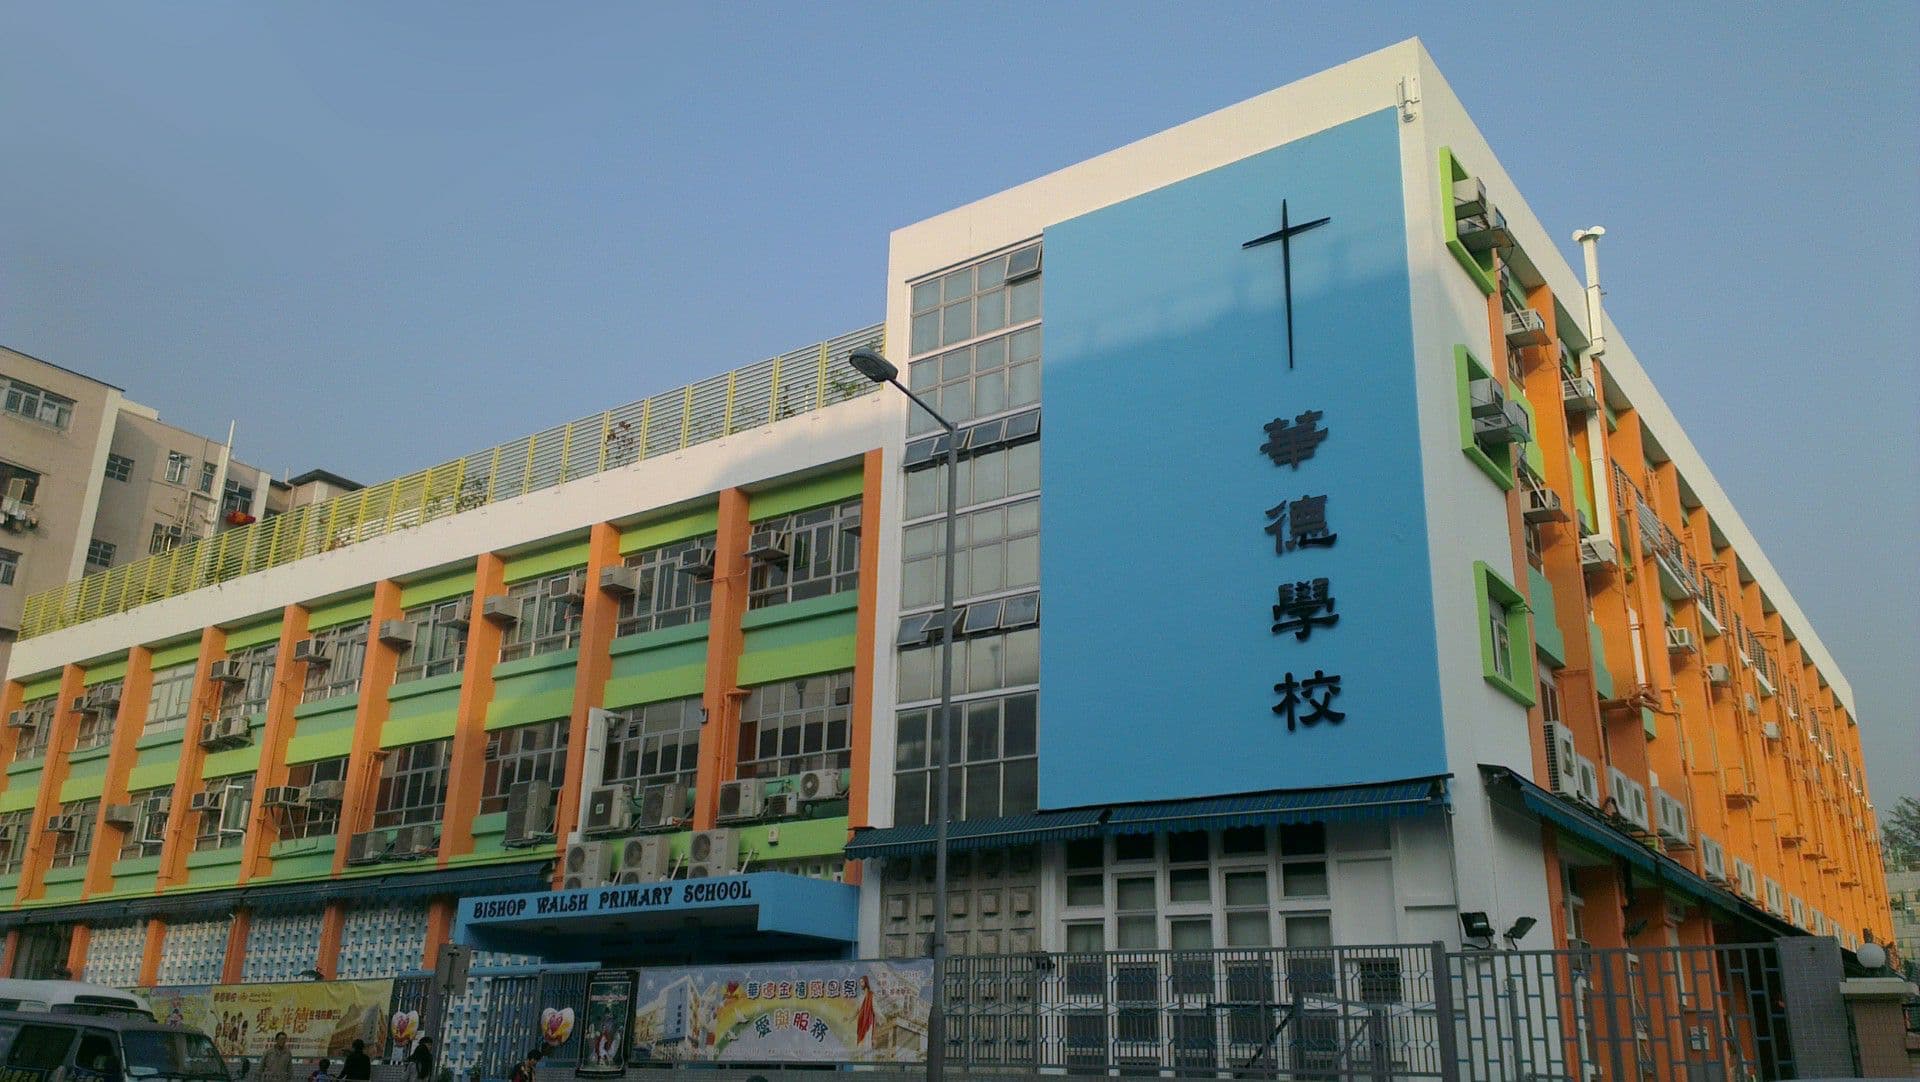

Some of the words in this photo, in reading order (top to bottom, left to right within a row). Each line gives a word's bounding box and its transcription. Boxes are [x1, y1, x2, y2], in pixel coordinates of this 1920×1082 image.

[1260, 409, 1346, 732] 華德學校
[473, 898, 527, 919] BISHOP
[537, 893, 589, 914] WALSH
[599, 886, 673, 910] PRIMARY
[683, 880, 752, 904] SCHOOL
[754, 1008, 829, 1042] 愛與服務
